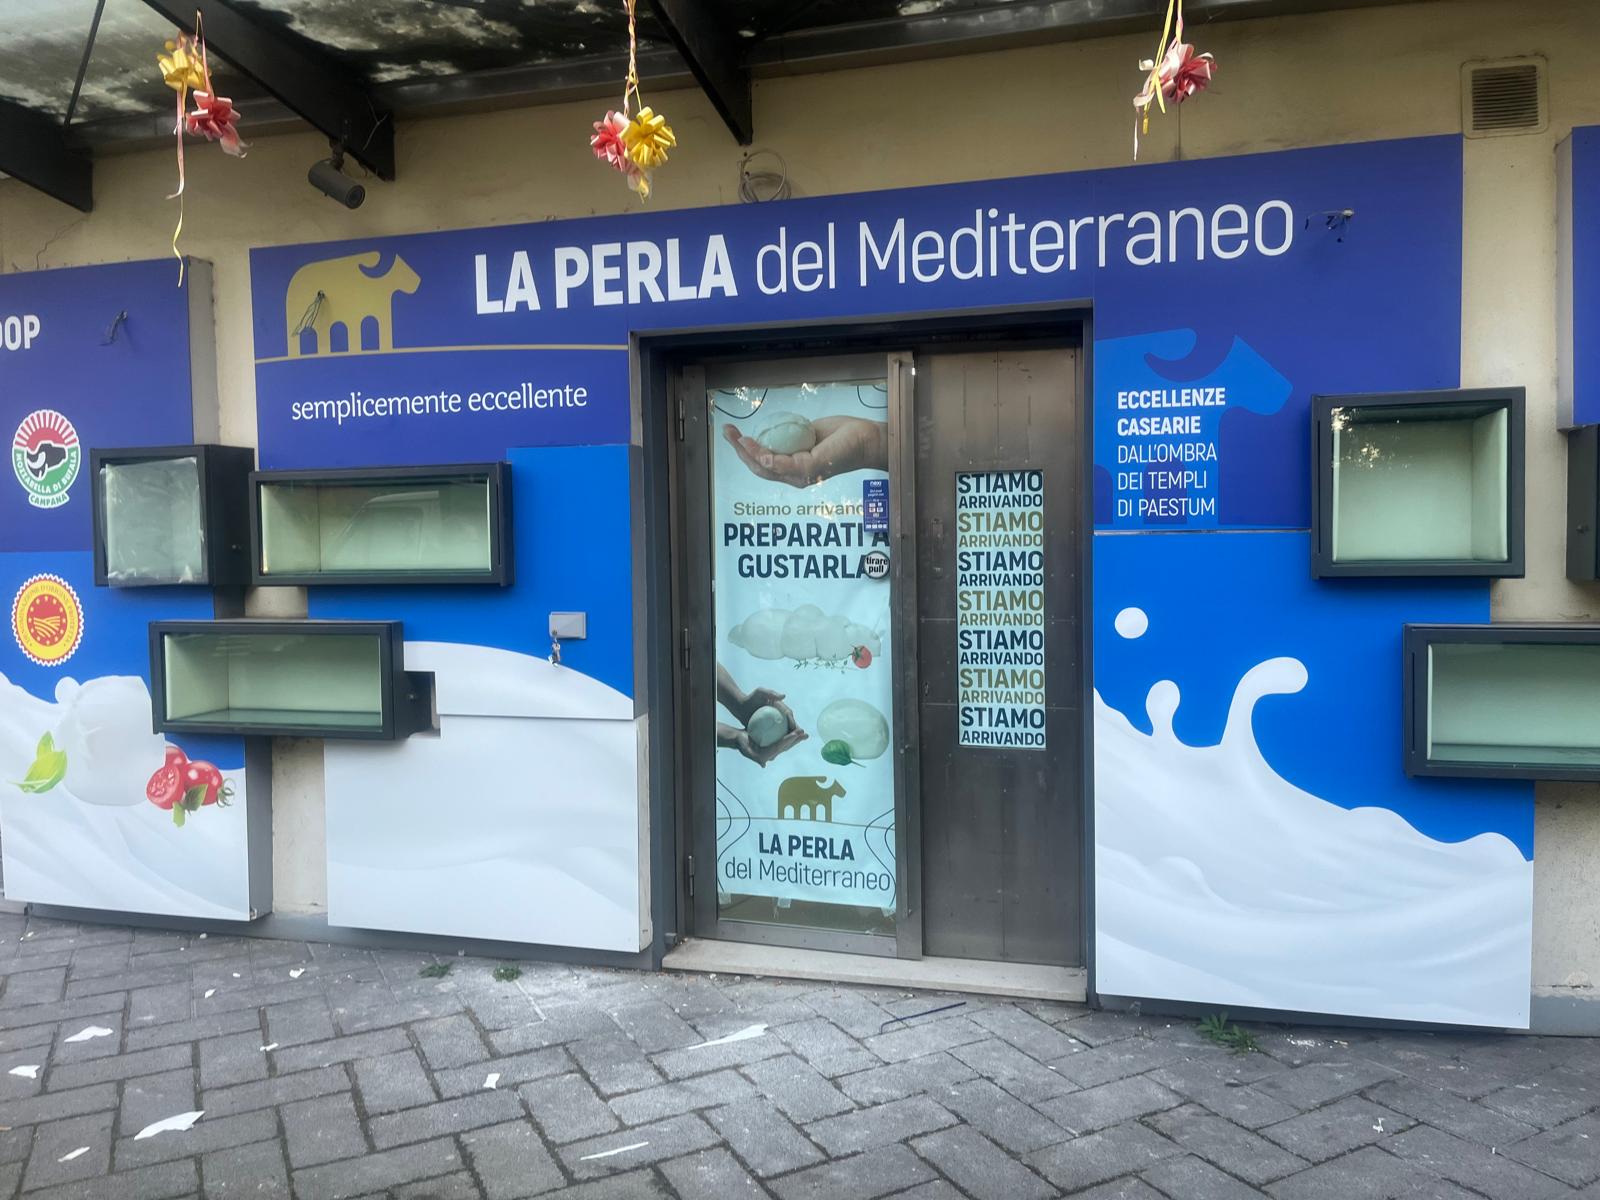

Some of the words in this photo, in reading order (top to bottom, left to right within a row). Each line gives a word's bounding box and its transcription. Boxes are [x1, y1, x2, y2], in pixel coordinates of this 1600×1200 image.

[475, 250, 541, 315] LA
[554, 234, 738, 309] PERLA
[756, 222, 837, 295] del
[859, 199, 1294, 288] Mediterraneo
[0, 315, 41, 351] OP
[292, 391, 462, 425] semplicemente
[467, 382, 588, 411] eccellente
[1117, 387, 1226, 409] ECCELLENZE
[1117, 416, 1201, 436] CASEARIE
[1118, 442, 1217, 463] DALL'OMBRA
[958, 471, 1043, 493] STIAMO
[1118, 472, 1143, 490] DEI
[1148, 470, 1207, 489] TEMPLI
[733, 502, 792, 517] Stiamo
[958, 494, 1043, 509] ARRIVANDO
[1118, 499, 1132, 517] DI
[1138, 497, 1215, 517] PAESTUM
[958, 511, 1043, 532] STIAMO
[724, 522, 863, 547] PREPARATI
[958, 533, 1043, 548] ARRIVANDO
[866, 556, 888, 565] tirare
[868, 564, 884, 574] pull
[958, 551, 1044, 571] STIAMO
[958, 573, 1044, 587] ARRIVANDO
[959, 590, 1044, 611] STIAMO
[959, 612, 1044, 627] ARRIVANDO
[959, 629, 1044, 650] STIAMO
[959, 651, 1044, 666] ARRIVANDO
[960, 668, 1044, 689] STIAMO
[960, 690, 1044, 705] ARRIVANDO
[960, 707, 1045, 729] STIAMO
[960, 730, 1045, 746] ARRIVANDO
[758, 832, 783, 856] LA
[788, 835, 855, 861] PERLA
[725, 856, 752, 879] del
[759, 858, 891, 891] Mediterraneo
